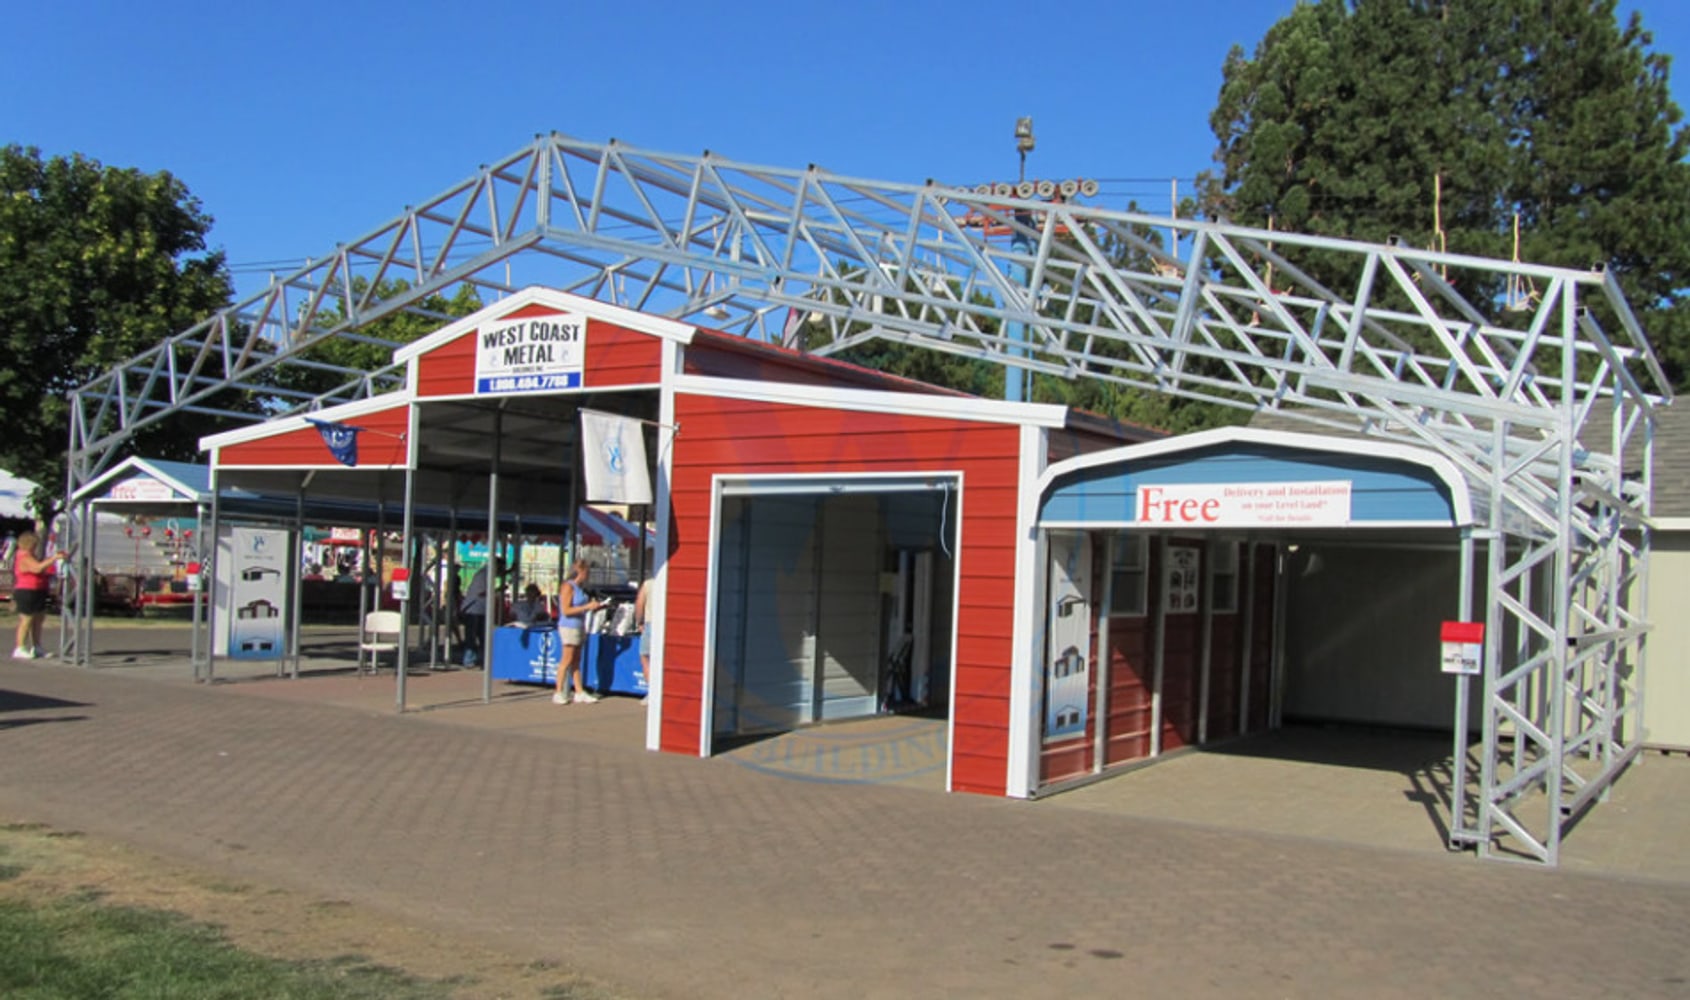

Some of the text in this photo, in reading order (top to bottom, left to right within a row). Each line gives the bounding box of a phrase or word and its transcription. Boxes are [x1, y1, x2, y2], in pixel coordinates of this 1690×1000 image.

[483, 320, 580, 349] WEST COAST
[503, 344, 555, 366] METAL
[1223, 485, 1348, 498] Delivery and Installation
[1139, 488, 1220, 522] Free
